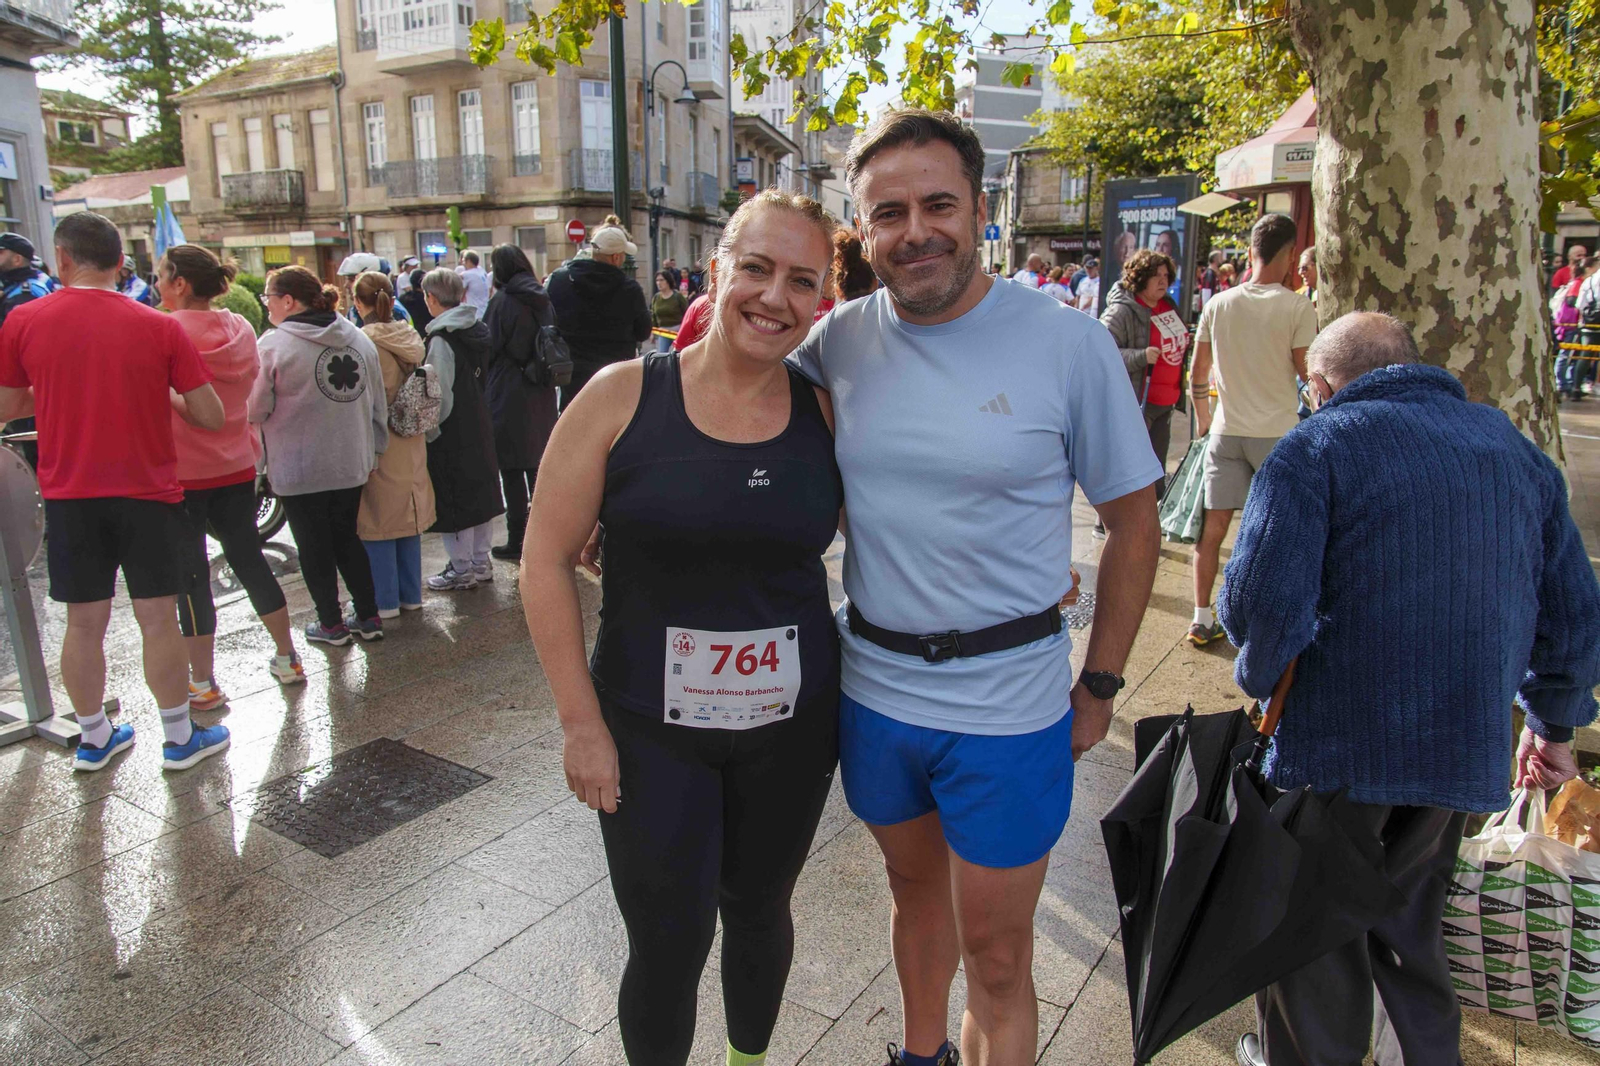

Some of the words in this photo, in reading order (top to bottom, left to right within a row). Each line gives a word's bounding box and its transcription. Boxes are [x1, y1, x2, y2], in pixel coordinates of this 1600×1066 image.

[1287, 151, 1313, 161] 11/11
[1122, 210, 1140, 224] 900
[1140, 208, 1158, 222] 830
[1159, 206, 1176, 221] 831
[679, 640, 690, 651] 14
[710, 640, 780, 676] 764
[683, 686, 715, 696] Vanessa
[716, 686, 744, 697] Alonso
[745, 686, 784, 697] Barbancho
